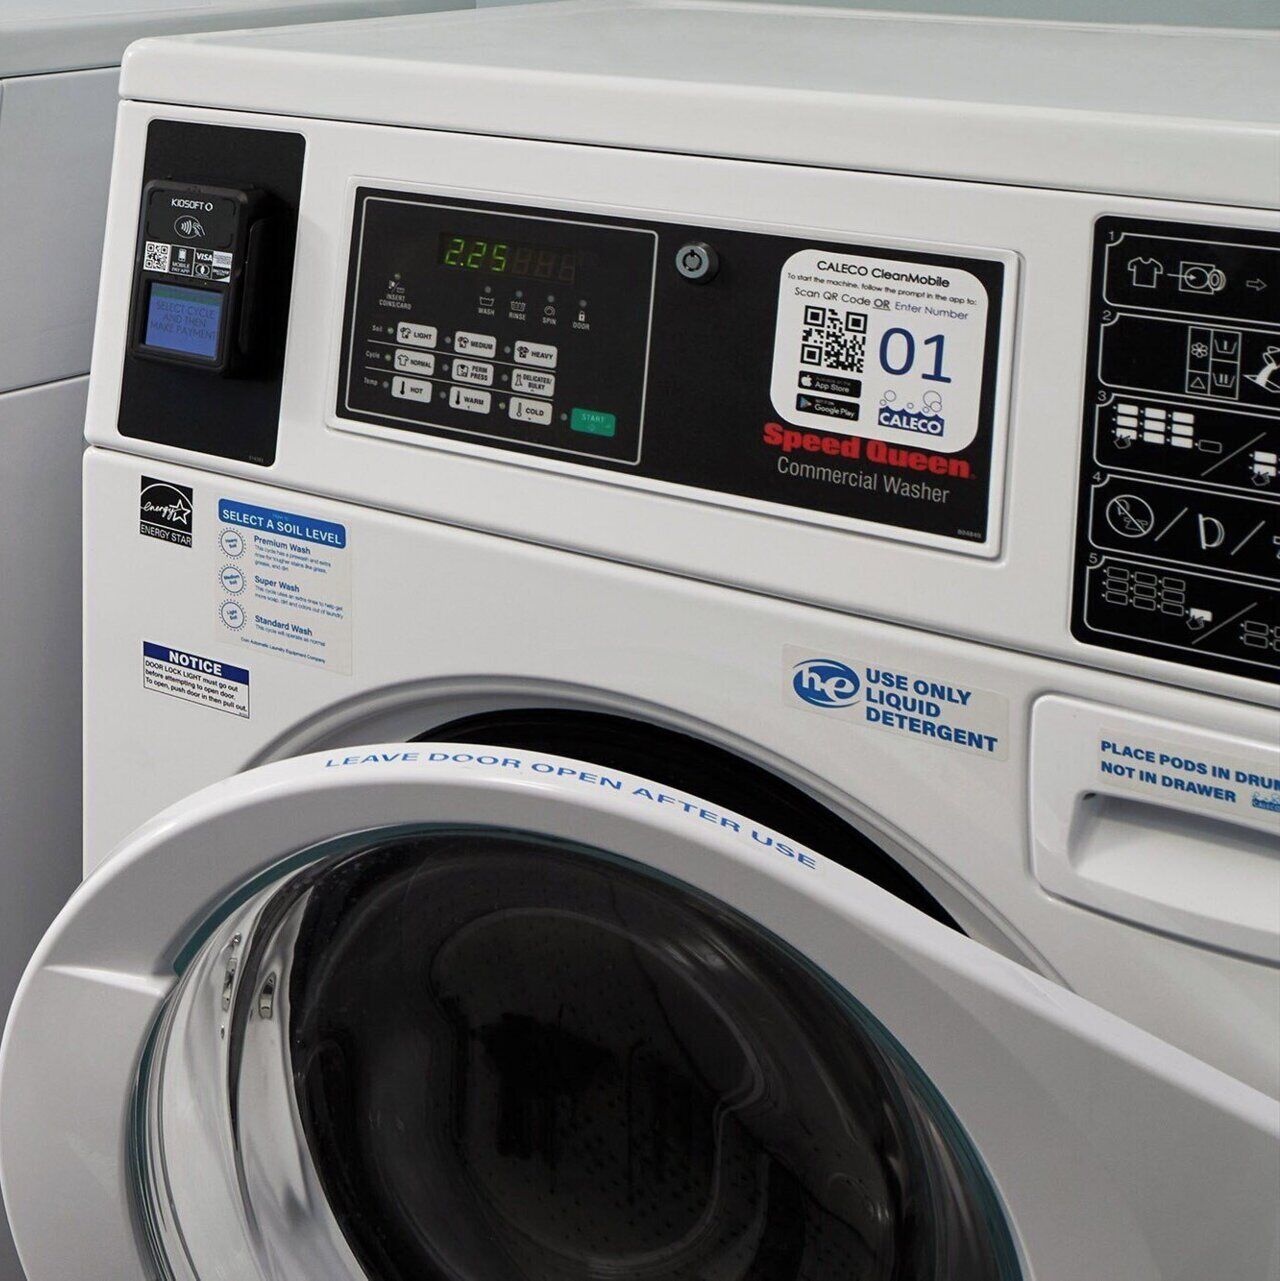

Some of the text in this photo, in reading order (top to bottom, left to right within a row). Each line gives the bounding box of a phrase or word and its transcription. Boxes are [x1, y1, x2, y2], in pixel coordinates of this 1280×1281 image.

[172, 198, 204, 210] KIOSOFT
[445, 239, 508, 272] 2.25
[817, 260, 950, 288] CALECO CleanMobile
[156, 301, 215, 318] SELECT CYCLE
[795, 287, 969, 320] Scan QR Code OR Enter Number
[151, 321, 174, 333] MAKE
[413, 332, 432, 341] LIGHT
[471, 340, 493, 351] MEDIUM
[410, 358, 431, 369] NORMAL
[531, 350, 553, 360] HEAVY
[879, 327, 952, 384] 01
[470, 371, 488, 381] PRESS
[472, 365, 488, 374] PERM
[410, 387, 423, 395] HOT
[528, 381, 545, 390] BULKY
[815, 381, 849, 393] App Store
[464, 395, 484, 406] WARM
[525, 407, 544, 416] COLD
[581, 413, 605, 423] START
[815, 403, 855, 419] Google Play
[879, 413, 942, 434] CALECO
[763, 422, 970, 478] Speed Queen
[777, 456, 950, 504] Commercial Washer
[141, 524, 192, 546] ENERGY STAR
[223, 509, 341, 545] SELECT A SOIL LEVEL
[254, 536, 310, 554] Premium Wash
[169, 651, 222, 676] NOTICE
[866, 668, 971, 706] USE ONLY
[866, 687, 941, 717] LIQUID
[866, 706, 998, 752] DETERGENT
[1101, 740, 1155, 763] PLACE
[1159, 754, 1208, 775] PODS
[1212, 766, 1230, 780] IN
[1101, 761, 1237, 802] NOT IN DRAWER
[325, 752, 818, 870] LEAVE DOOR OPEN AFTER USE
